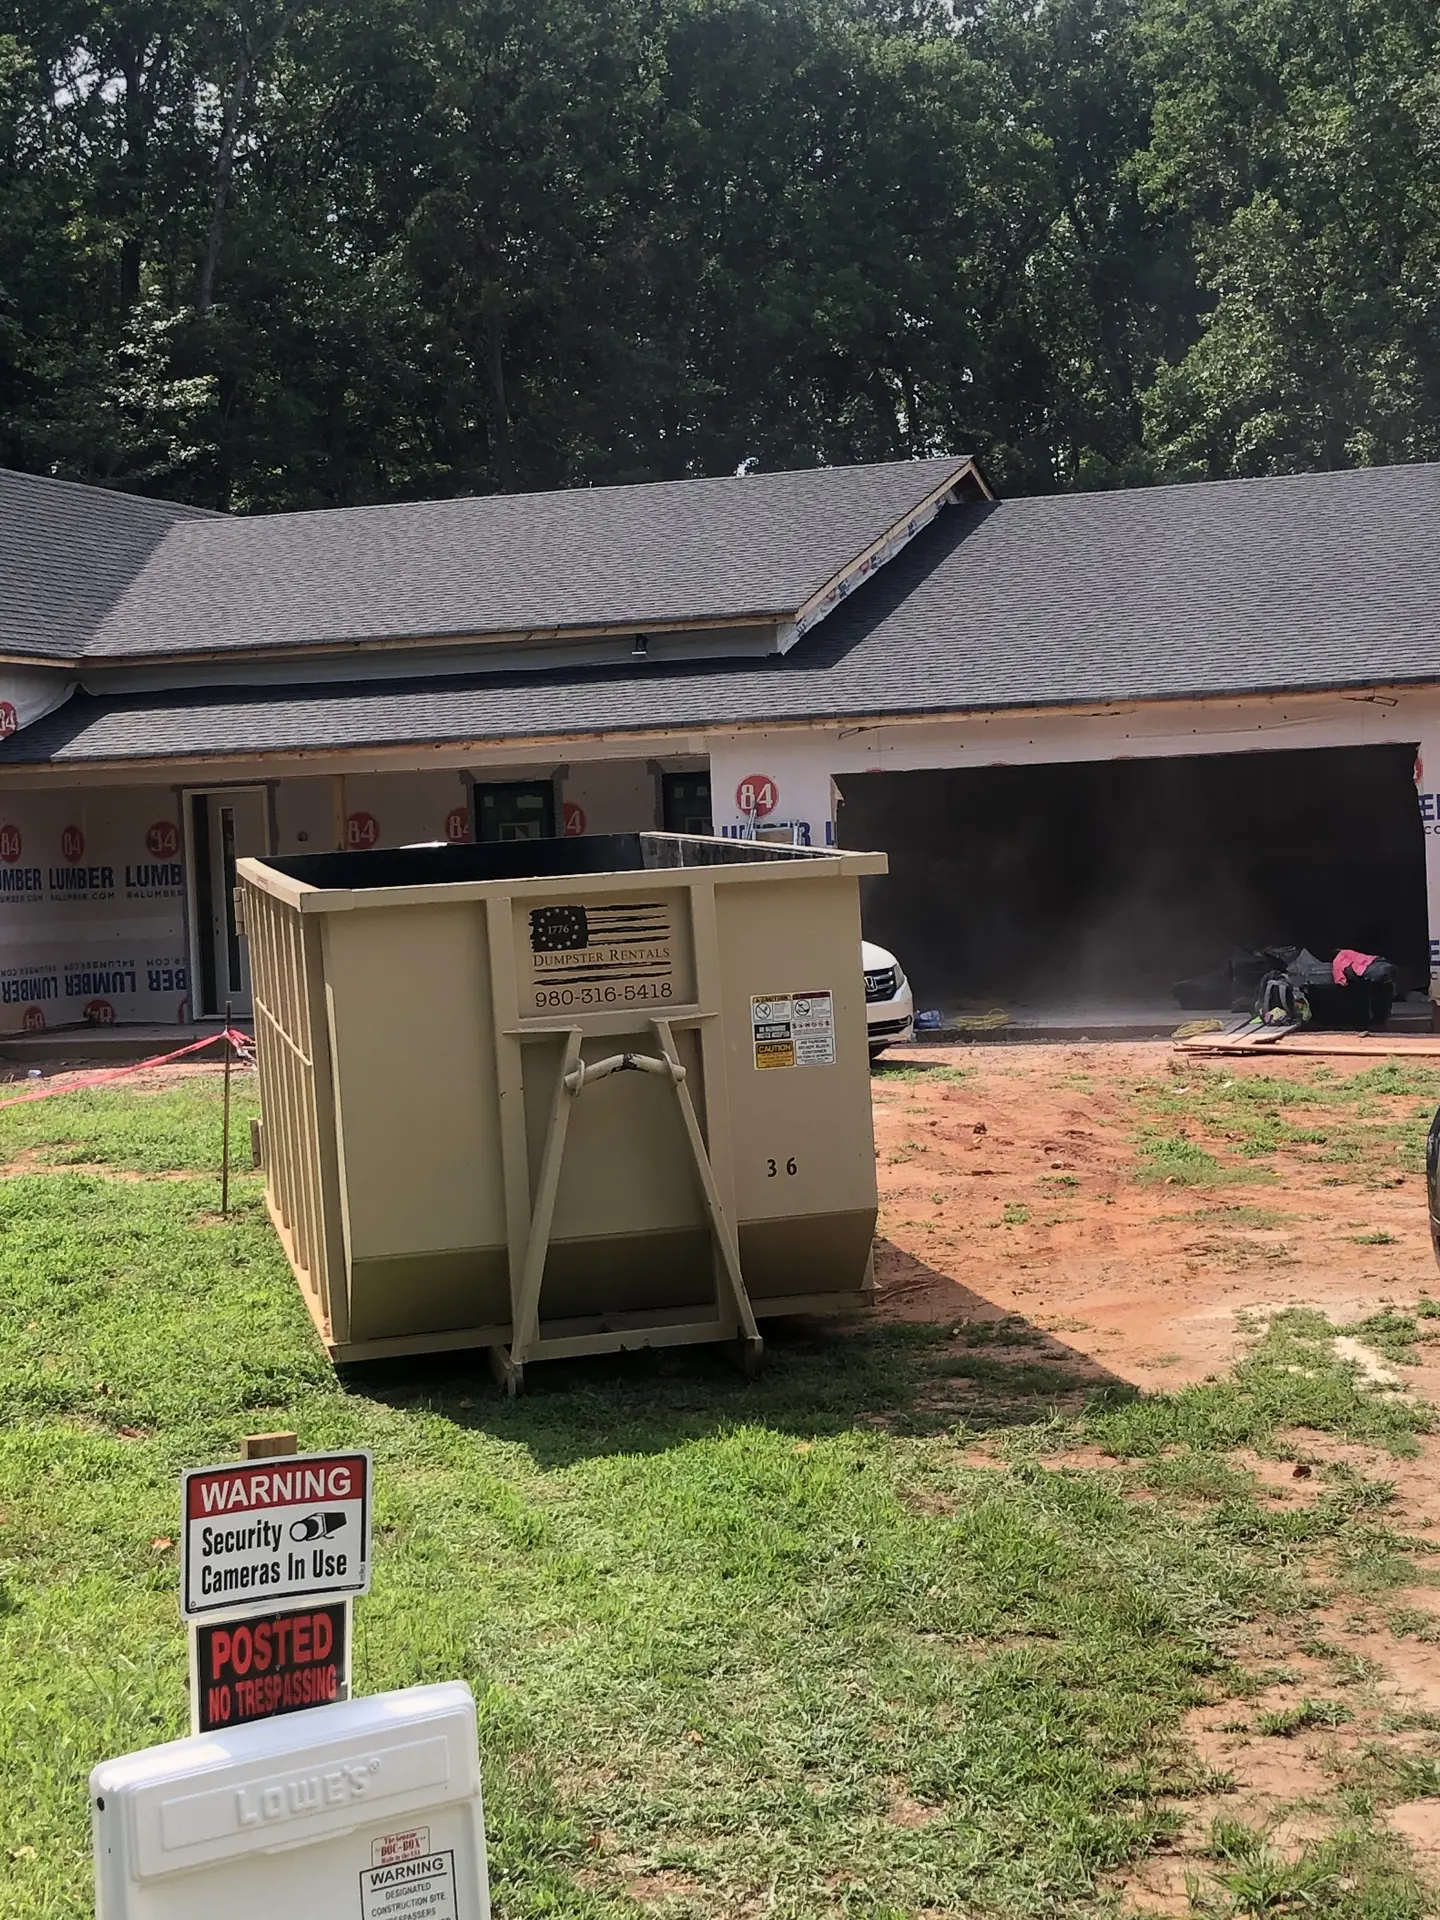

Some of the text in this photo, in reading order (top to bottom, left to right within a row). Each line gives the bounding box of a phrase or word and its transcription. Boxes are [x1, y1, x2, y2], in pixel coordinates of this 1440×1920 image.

[740, 783, 773, 809] 84
[0, 868, 42, 891] MBER
[49, 867, 114, 890] LUMBER
[548, 925, 569, 934] 1776
[533, 948, 670, 967] DUMPSTER RENTALS
[2, 976, 58, 1003] LUMBER
[66, 971, 136, 996] LUMBER
[535, 983, 673, 1008] 980-316-5418
[200, 1466, 351, 1513] WARNING
[202, 1519, 282, 1557] Security
[202, 1560, 280, 1595] Cameras
[288, 1552, 305, 1581] In
[312, 1549, 347, 1579] Use
[211, 1612, 333, 1680] POSTED
[207, 1664, 337, 1723] NO TRESPASSING
[381, 1838, 420, 1857] DOC-BOX
[370, 1858, 444, 1886] WARNING
[385, 1882, 431, 1901] DESIGNATED
[371, 1896, 428, 1917] CONSTRUCTION
